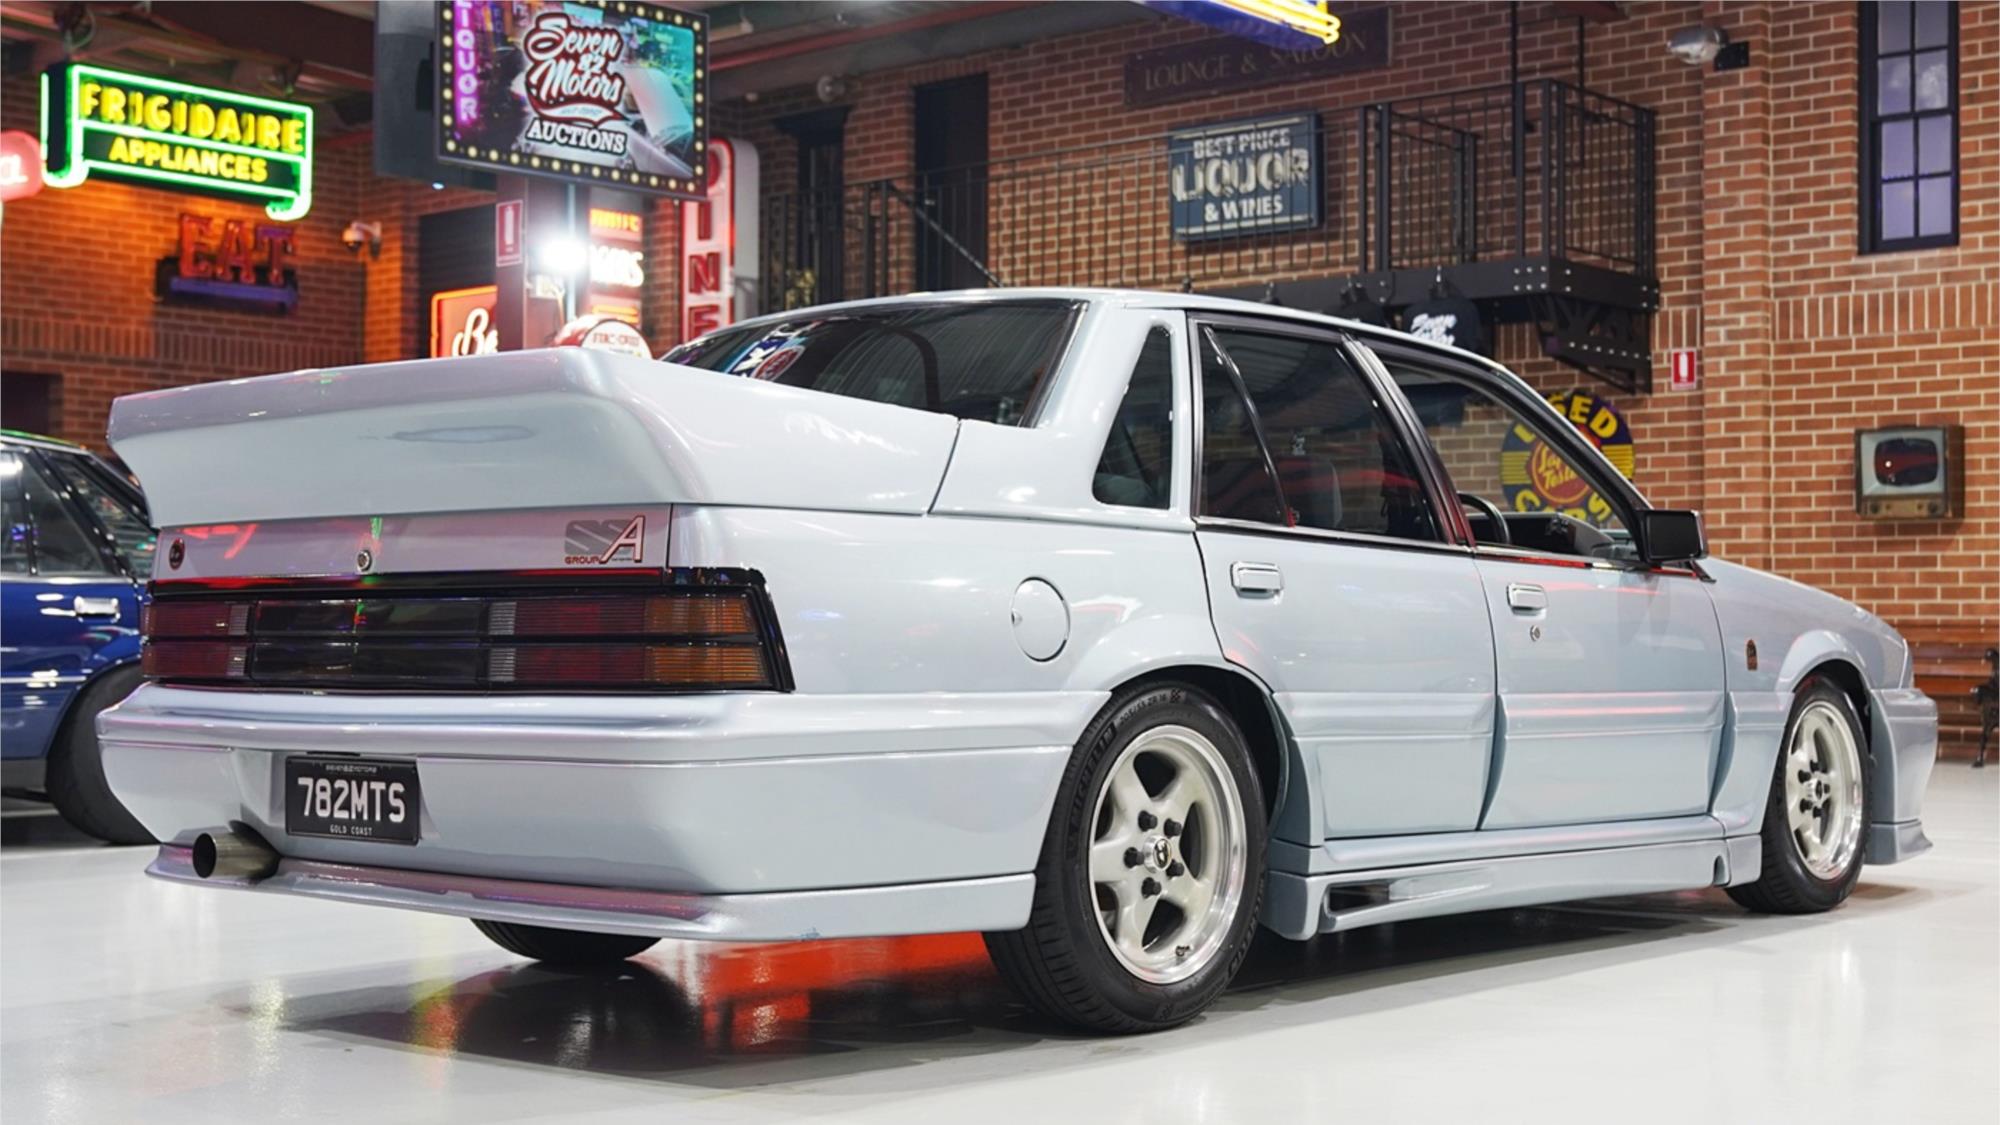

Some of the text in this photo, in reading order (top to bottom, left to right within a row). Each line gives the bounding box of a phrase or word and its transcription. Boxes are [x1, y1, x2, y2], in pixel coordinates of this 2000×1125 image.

[527, 17, 620, 61] Seven
[529, 58, 622, 102] Motors
[577, 52, 606, 74] 82
[1145, 54, 1231, 91] LOUNGE
[1240, 53, 1258, 74] &
[80, 81, 306, 154] FRIGIDAIRE
[526, 119, 626, 154] AUCTIONS
[109, 137, 268, 184] APPLIANCES
[1193, 127, 1290, 159] BEST PRICE
[1171, 147, 1309, 203] LIQUOR
[1204, 194, 1283, 223] & WINES
[178, 211, 295, 286] EAT
[564, 514, 646, 565] GROUP A
[297, 776, 406, 824] 782MTS
[329, 823, 373, 836] GOLD COAST
